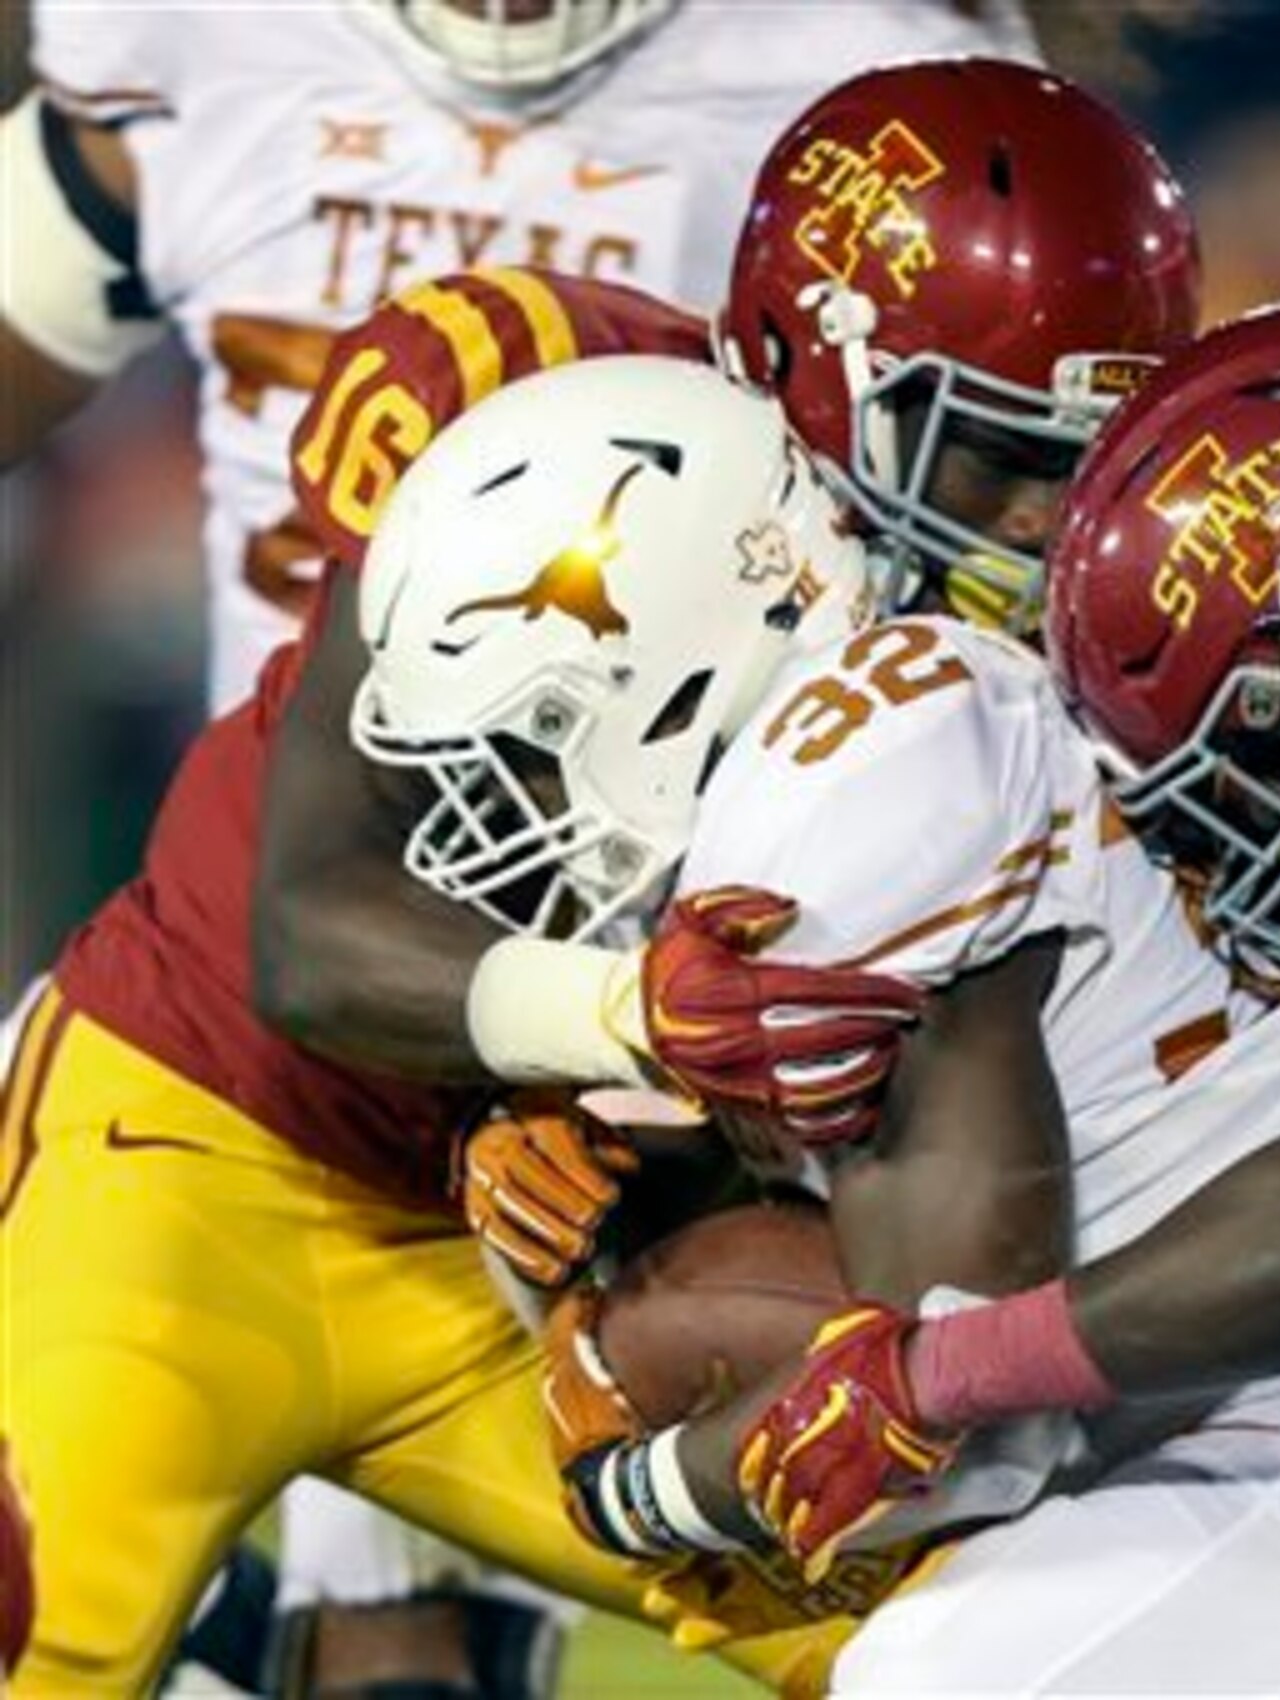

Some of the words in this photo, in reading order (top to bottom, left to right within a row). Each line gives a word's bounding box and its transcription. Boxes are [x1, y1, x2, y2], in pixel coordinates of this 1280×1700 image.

[788, 137, 937, 298] STATE
[296, 347, 432, 537] 16
[760, 622, 975, 768] 32
